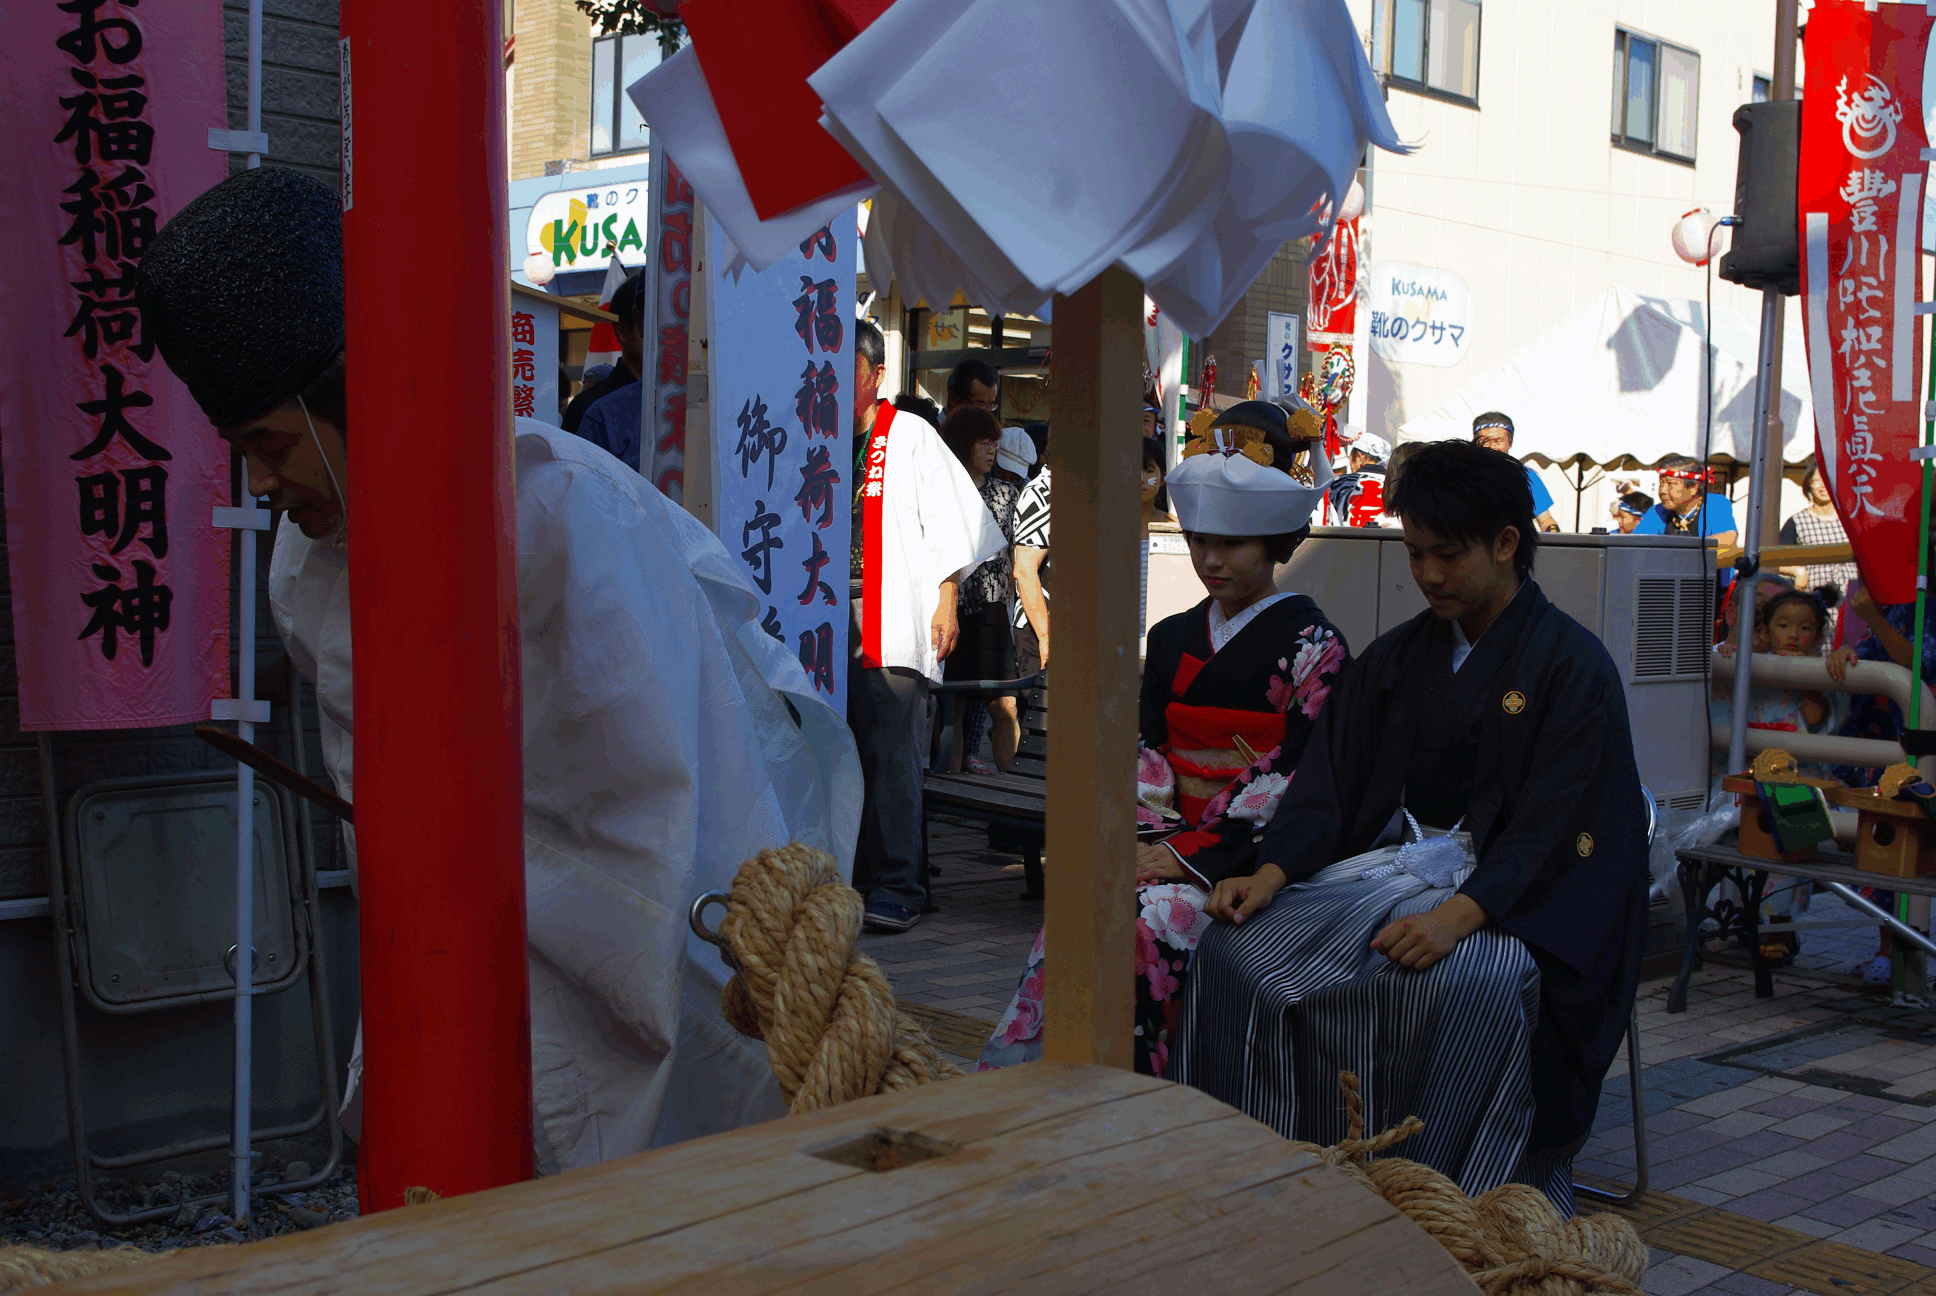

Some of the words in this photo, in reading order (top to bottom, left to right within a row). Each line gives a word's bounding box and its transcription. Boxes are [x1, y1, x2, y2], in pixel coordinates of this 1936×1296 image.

[586, 186, 649, 209] 靴のク
[552, 212, 648, 267] KUSA
[1391, 277, 1448, 302] KUSAMA
[1370, 310, 1465, 348] 靴のクサマ
[865, 435, 888, 498] きつね祭
